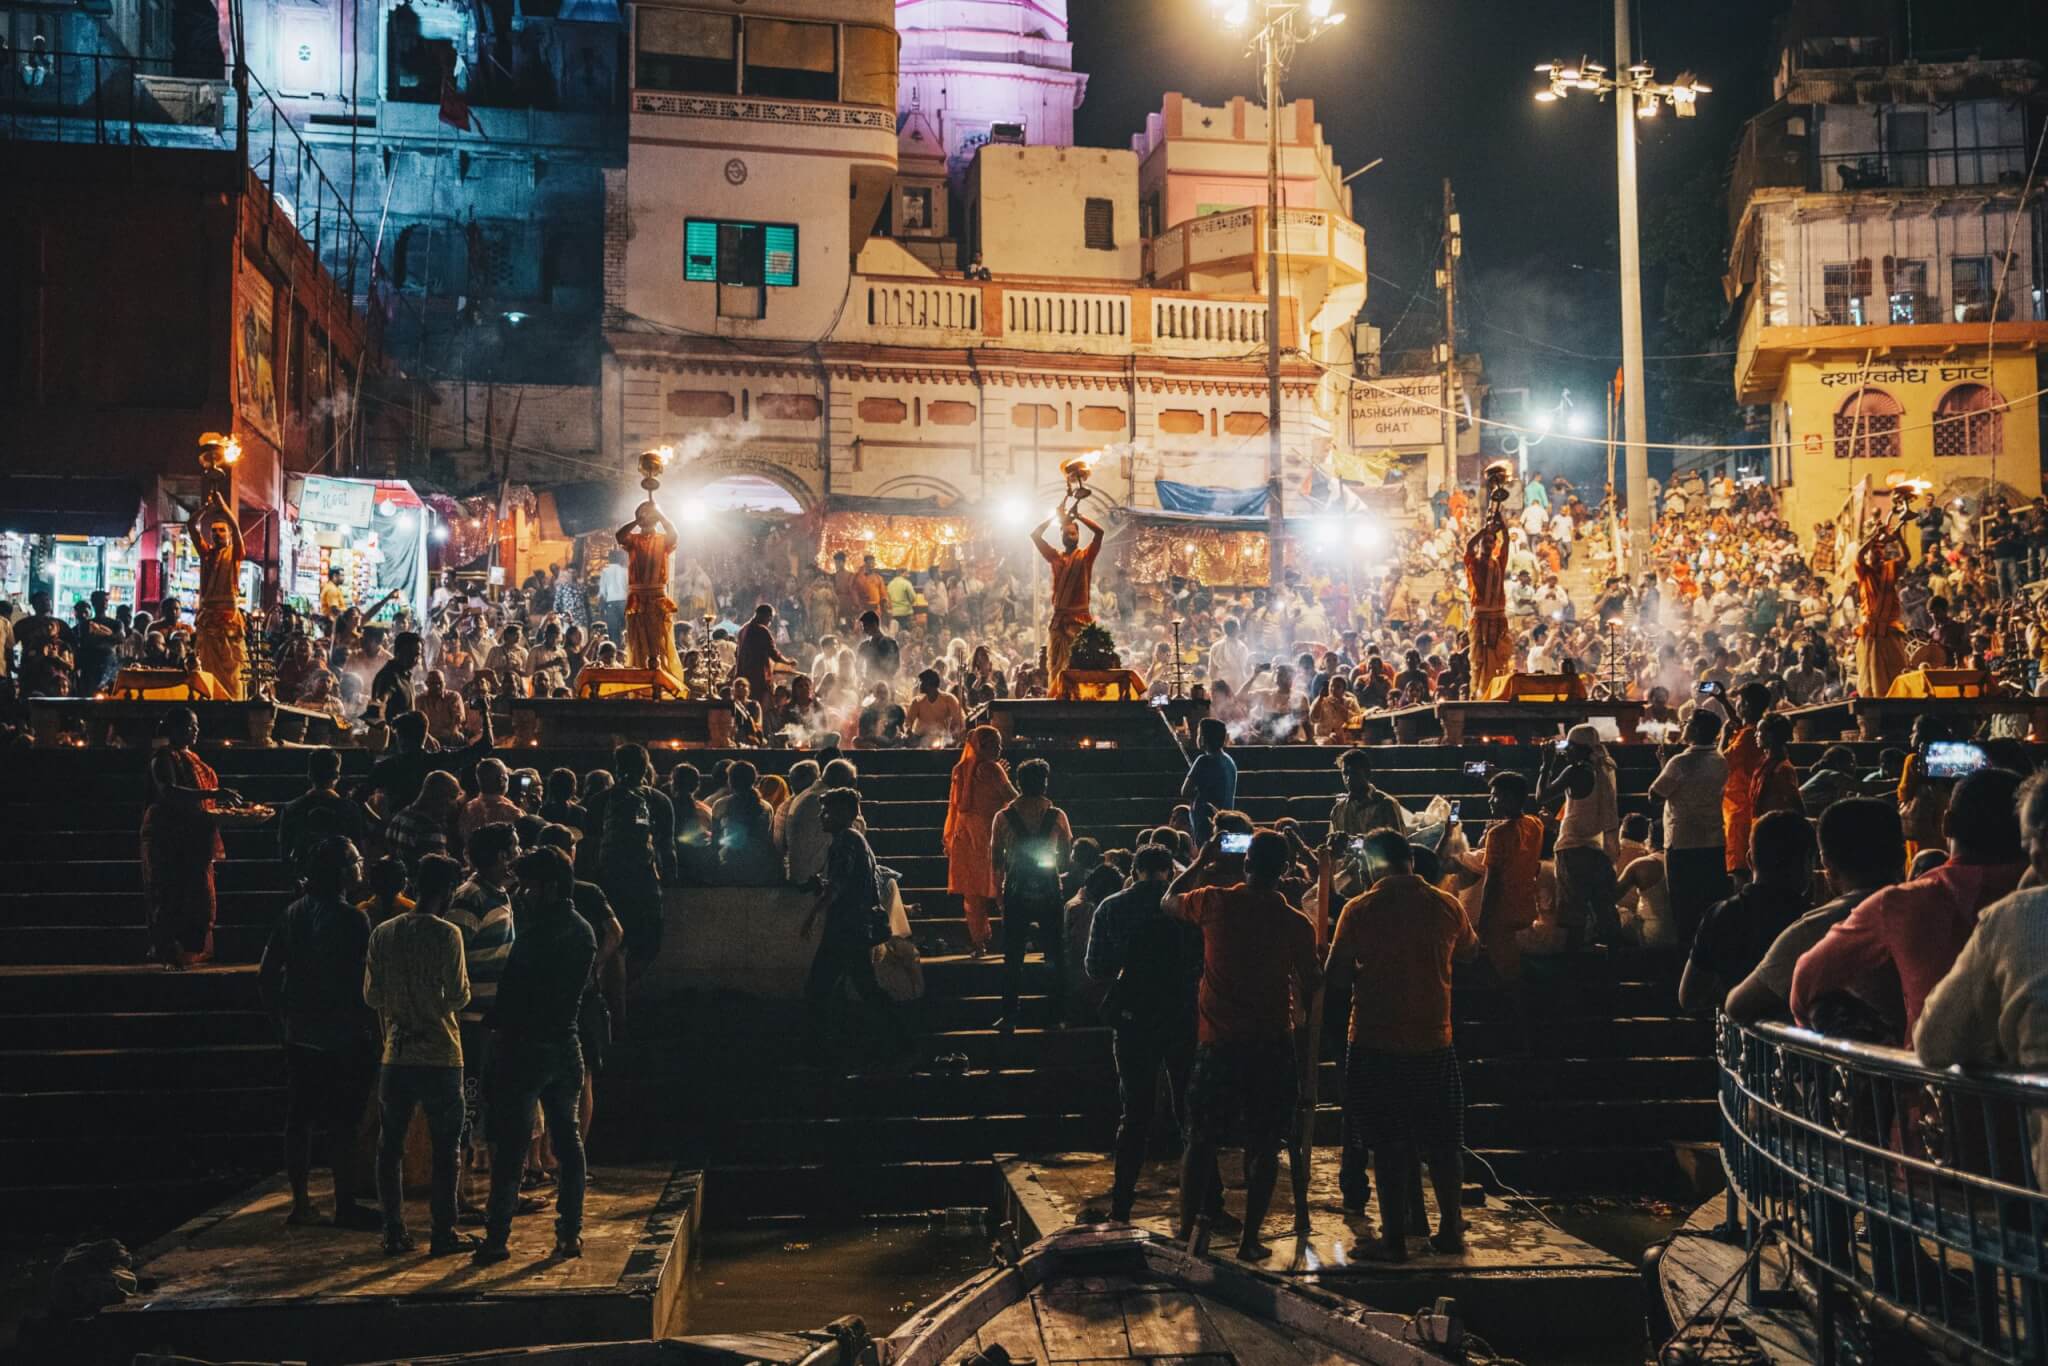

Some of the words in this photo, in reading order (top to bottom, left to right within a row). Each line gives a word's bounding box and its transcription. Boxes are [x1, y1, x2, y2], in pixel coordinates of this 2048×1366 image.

[1939, 366, 1989, 382] घाट
[1418, 384, 1440, 396] घाट
[1375, 422, 1409, 433] GHAT
